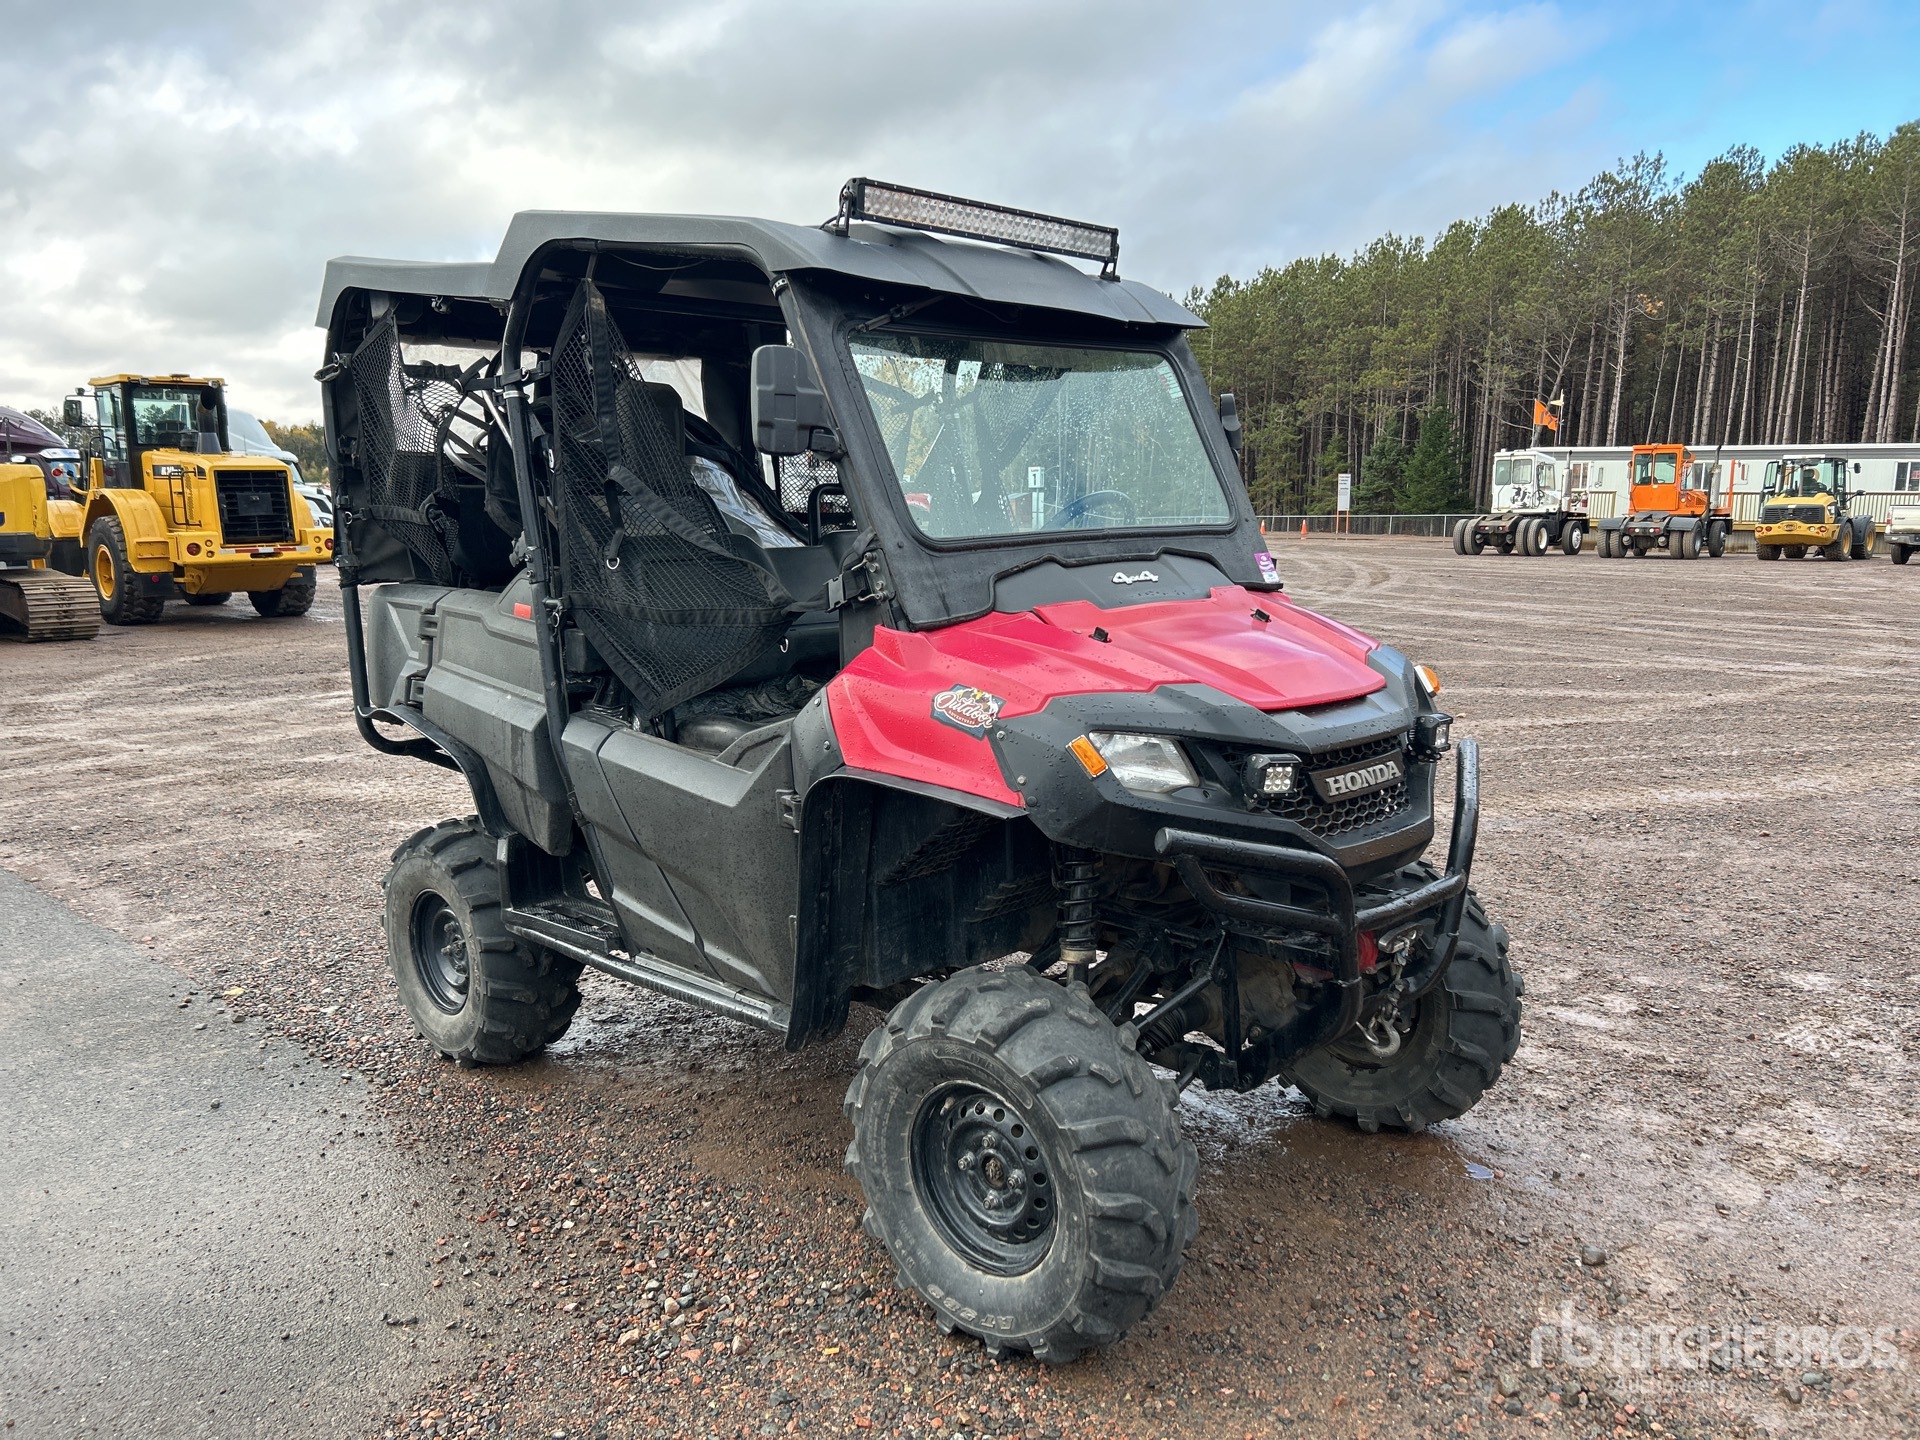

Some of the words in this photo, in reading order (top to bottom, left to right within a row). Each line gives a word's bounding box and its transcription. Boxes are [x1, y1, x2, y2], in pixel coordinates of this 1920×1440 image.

[1032, 473, 1037, 486] 1
[1112, 570, 1159, 585] 4x4
[935, 691, 993, 727] Outdoor
[1325, 760, 1401, 796] HONDA
